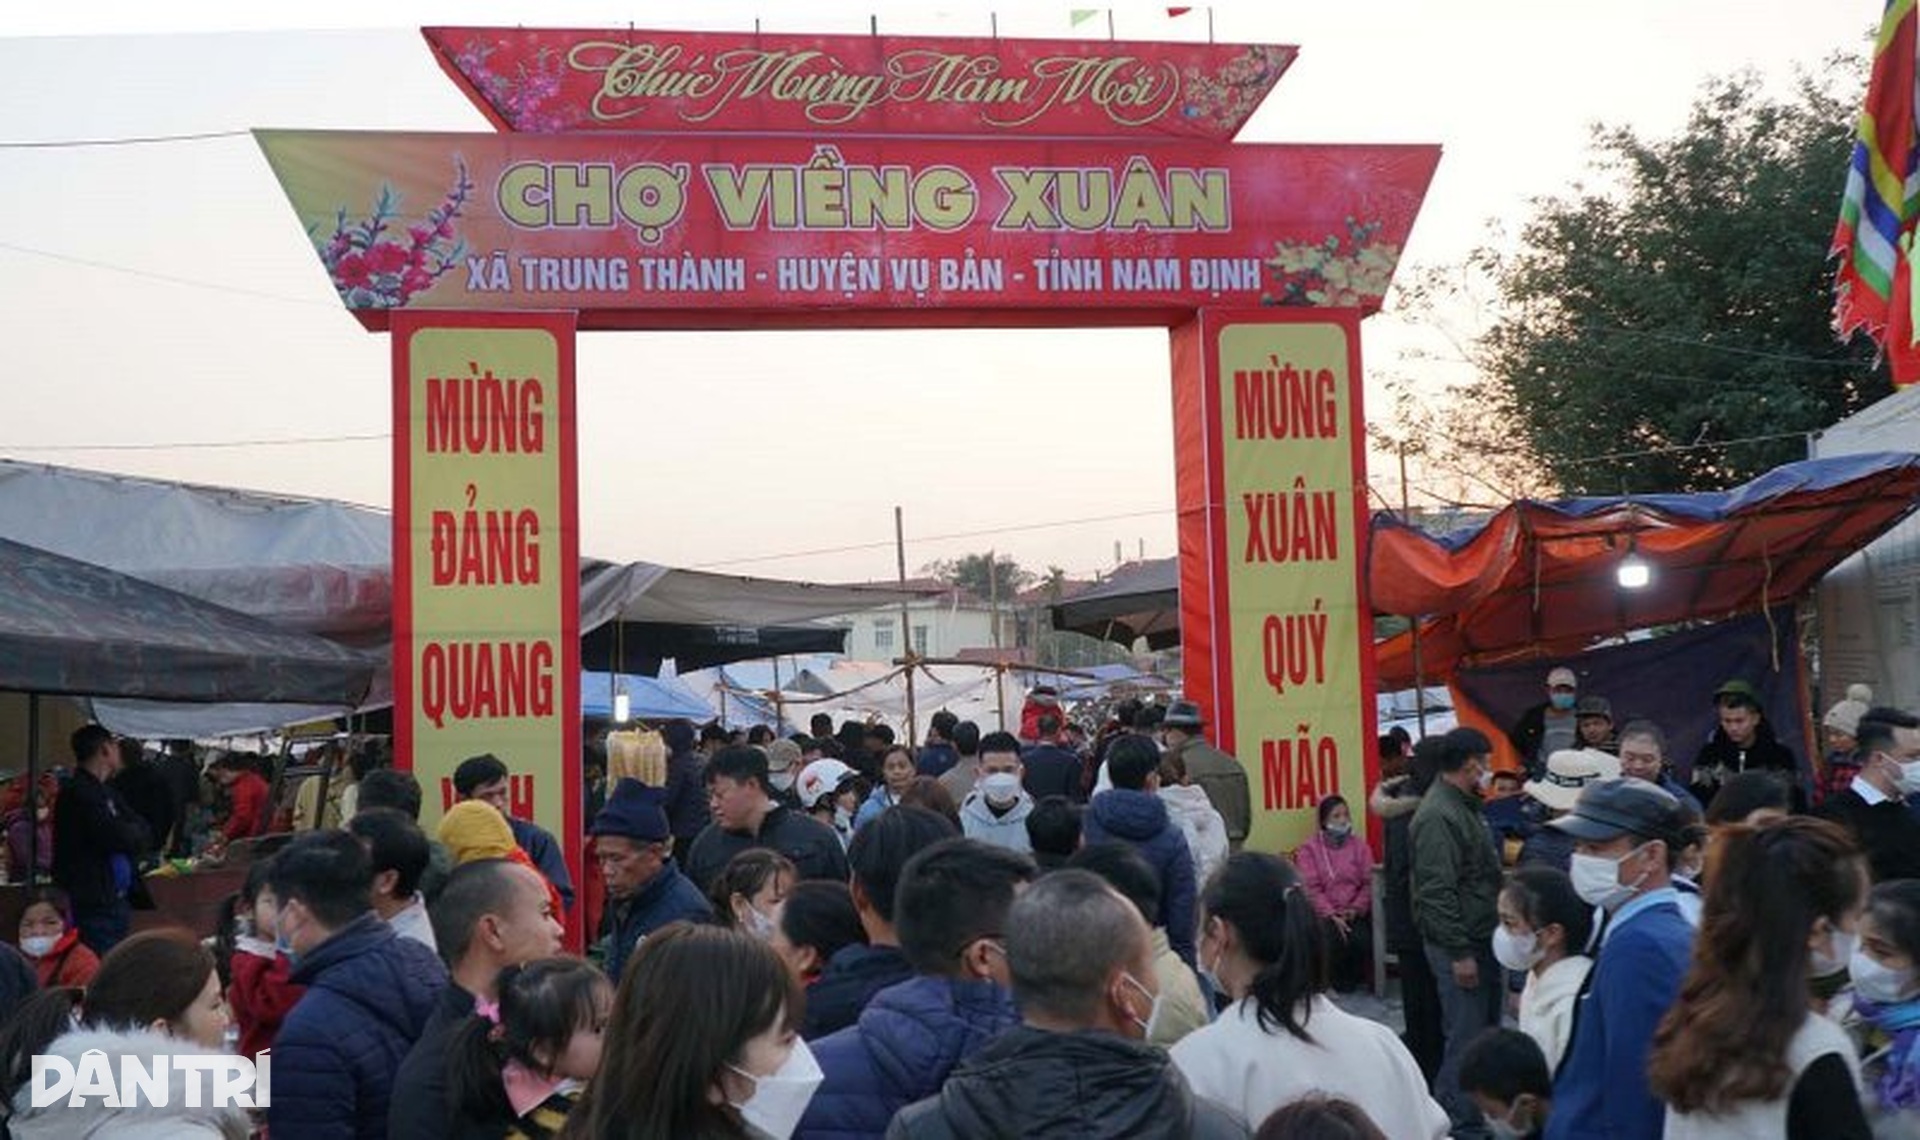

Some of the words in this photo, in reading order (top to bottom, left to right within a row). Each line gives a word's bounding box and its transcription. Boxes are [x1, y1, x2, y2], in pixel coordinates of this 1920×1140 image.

[568, 41, 714, 121] Chúc
[678, 49, 888, 124] Mừng
[886, 50, 1028, 102] Năm
[980, 56, 1180, 127] Mới
[496, 160, 691, 246] CHỢ
[701, 143, 978, 232] VIỀNG
[991, 155, 1232, 234] XUÂN
[466, 251, 512, 291] XÃ
[520, 257, 629, 292] TRUNG
[639, 251, 745, 292] THÀNH
[778, 251, 881, 299] HUYỆN
[890, 258, 931, 299] VỤ
[939, 247, 1003, 292] BẢN
[1034, 248, 1102, 292] TỈNH
[1112, 258, 1181, 292] NAM
[1190, 258, 1262, 297] ĐỊNH
[426, 360, 544, 454] MỪNG
[1233, 354, 1338, 440] MỪNG
[431, 483, 541, 586] ĐẢNG
[1242, 476, 1338, 563] XUÂN
[421, 641, 554, 729] QUANG
[1262, 598, 1328, 694] QUÝ
[1262, 723, 1340, 811] MÃO
